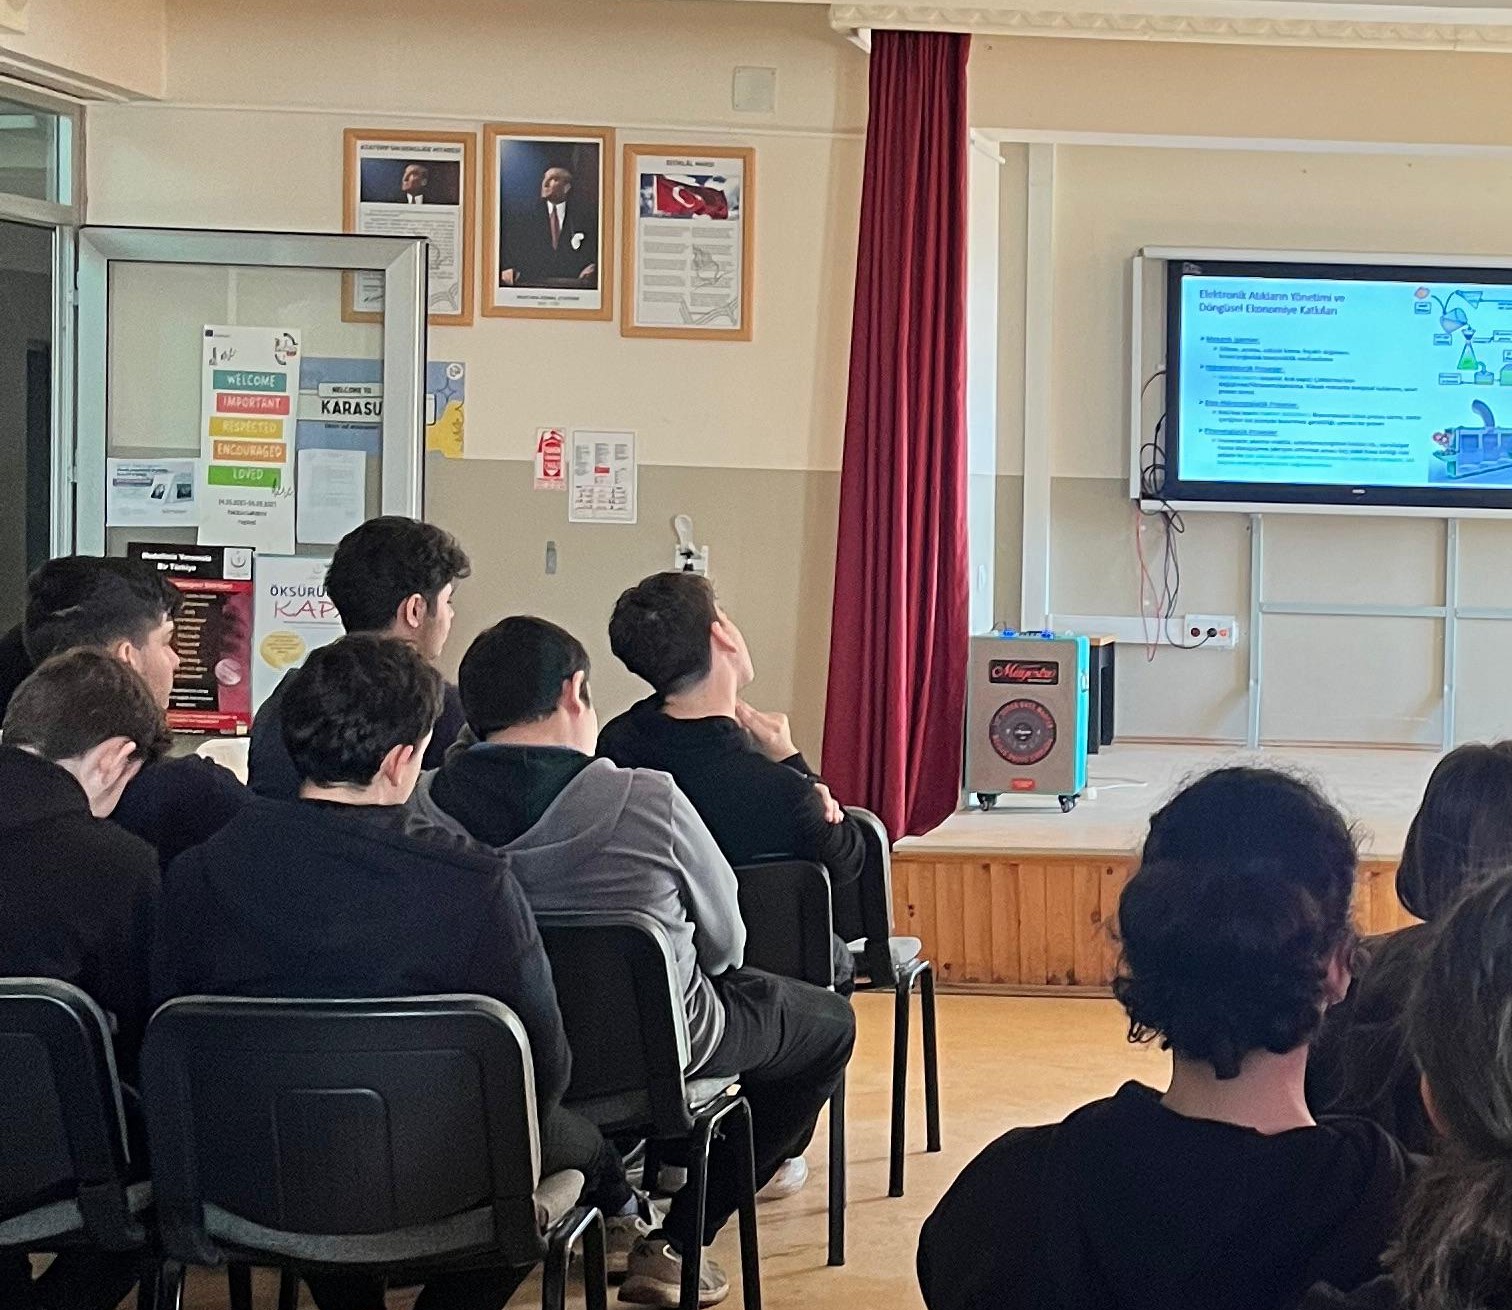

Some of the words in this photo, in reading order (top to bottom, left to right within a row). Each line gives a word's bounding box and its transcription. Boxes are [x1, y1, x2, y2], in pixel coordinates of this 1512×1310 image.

[1199, 289, 1247, 300] Elektronik
[1334, 294, 1346, 303] ve
[226, 373, 276, 388] WELCOME
[223, 395, 281, 409] IMPORTANT
[320, 399, 383, 416] KARASU
[222, 419, 278, 434] RESPECTED
[217, 442, 283, 458] ENCOURAGED
[232, 468, 264, 481] LOVED
[273, 599, 340, 619] KAP
